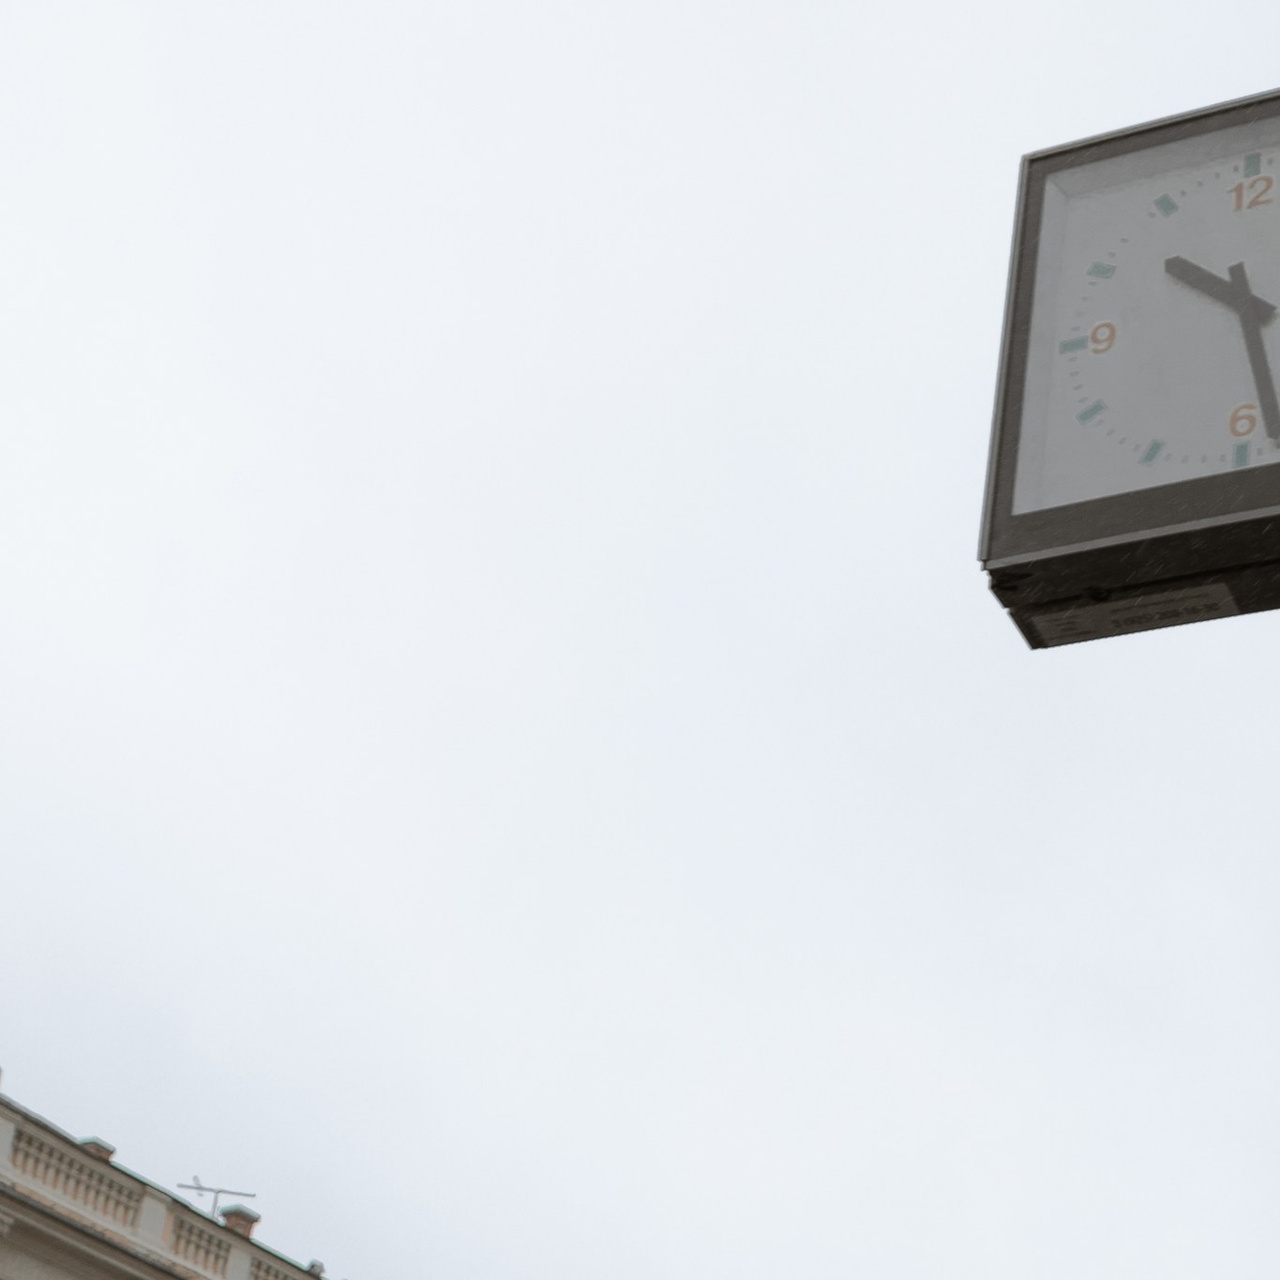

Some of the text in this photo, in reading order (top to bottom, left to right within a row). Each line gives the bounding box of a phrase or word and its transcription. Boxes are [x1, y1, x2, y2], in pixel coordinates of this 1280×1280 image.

[1228, 175, 1275, 212] 12
[1089, 322, 1116, 354] 9
[1228, 403, 1257, 437] 6
